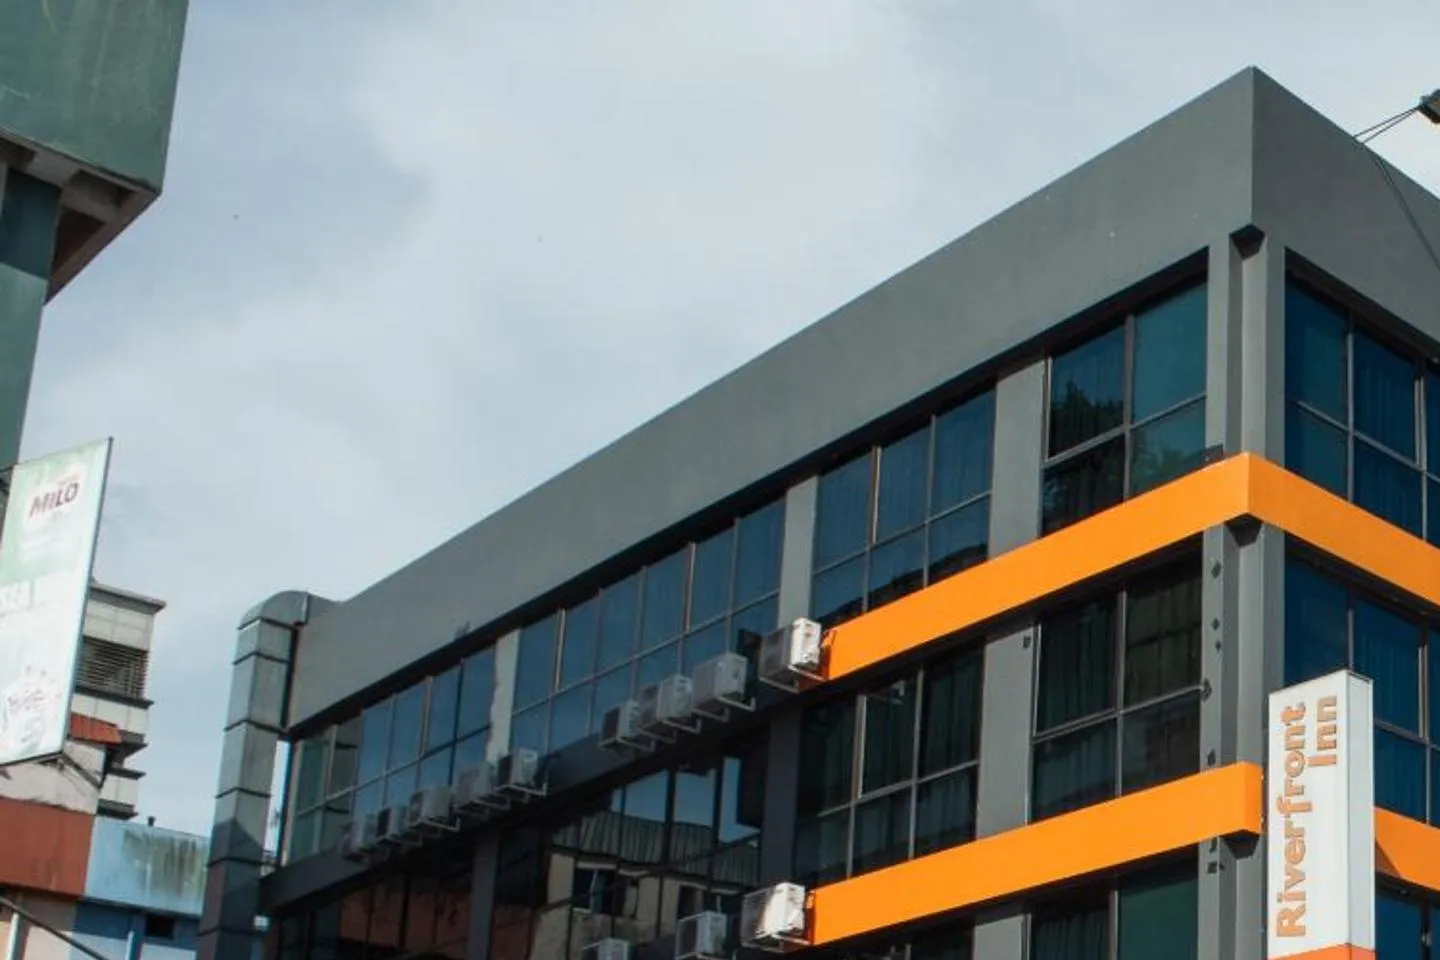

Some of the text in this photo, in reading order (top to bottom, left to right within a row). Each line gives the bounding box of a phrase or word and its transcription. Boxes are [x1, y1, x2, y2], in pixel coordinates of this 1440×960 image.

[29, 482, 79, 518] MILO
[1308, 695, 1338, 767] Inn
[1276, 701, 1313, 938] Riverfront
